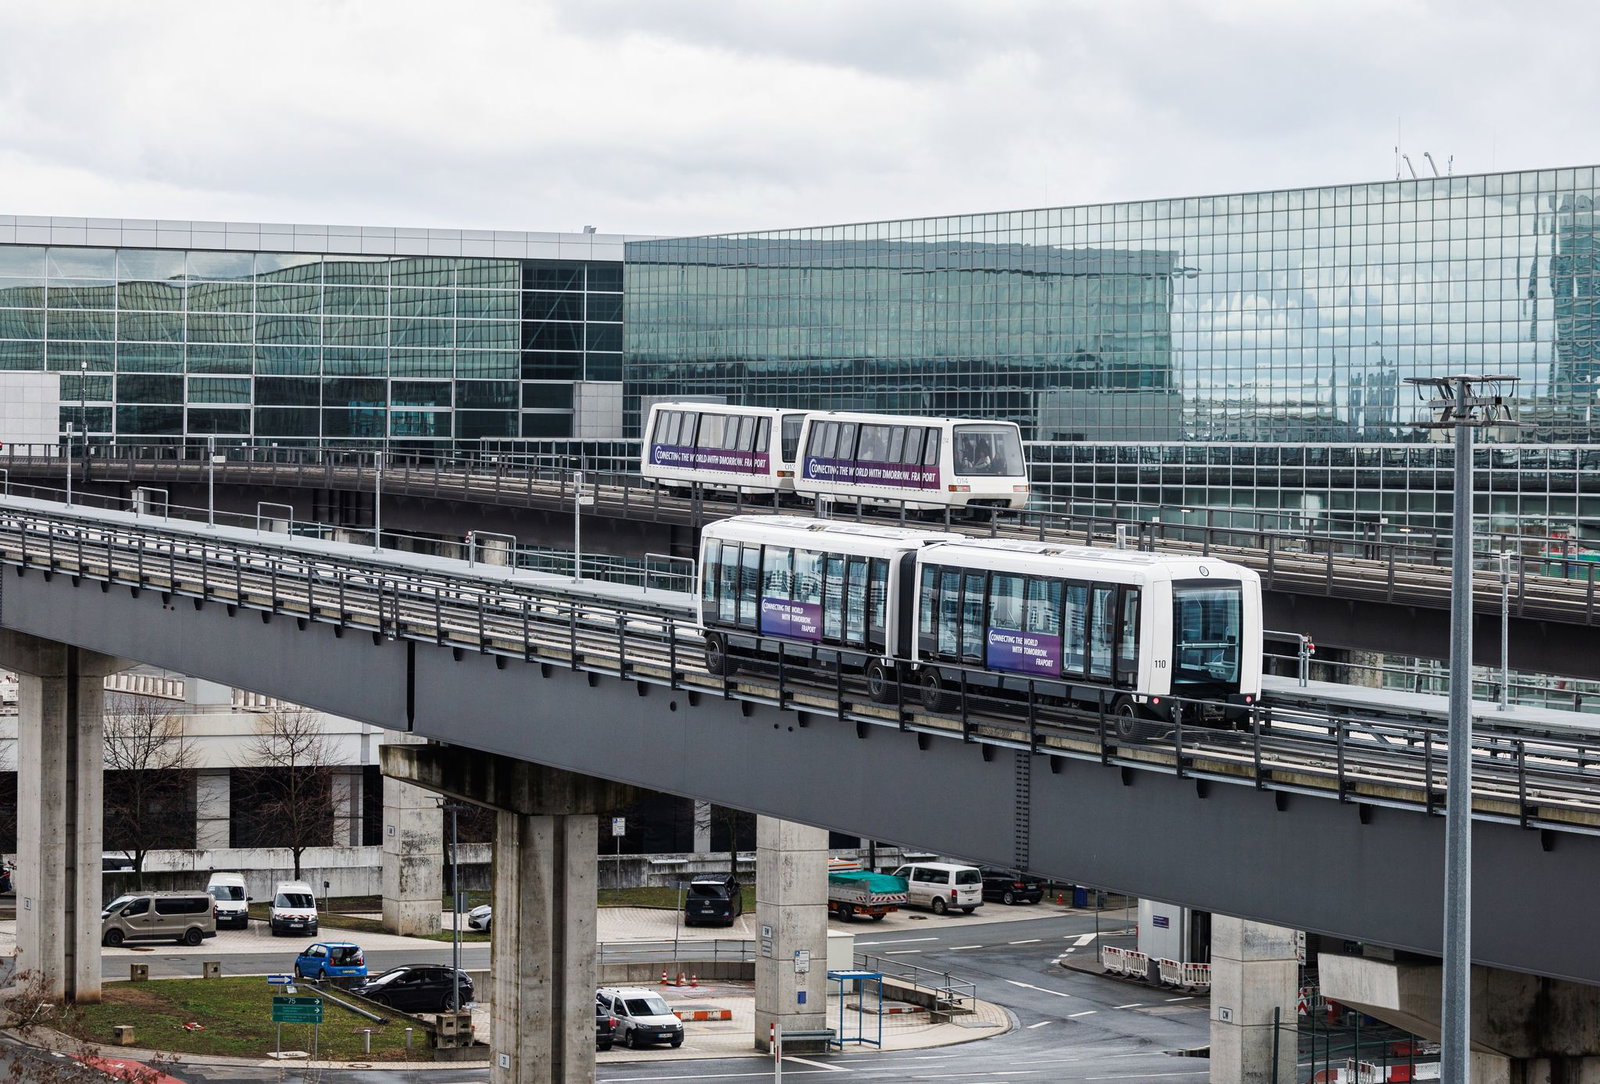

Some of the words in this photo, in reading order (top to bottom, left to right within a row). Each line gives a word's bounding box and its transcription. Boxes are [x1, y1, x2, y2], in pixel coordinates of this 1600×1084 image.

[707, 455, 719, 464] WITH
[744, 458, 766, 468] FRAPORT
[839, 466, 848, 476] THE
[849, 467, 868, 477] WORLD
[869, 468, 881, 478] WITH
[911, 472, 936, 482] FRAPORT
[791, 606, 804, 614] WORLD
[801, 625, 816, 633] FRAPORT
[1015, 636, 1023, 644] THE
[1023, 637, 1039, 647] WORLD
[1012, 646, 1023, 654] WITH
[1035, 658, 1053, 667] FRAPORT
[1154, 660, 1166, 668] 110
